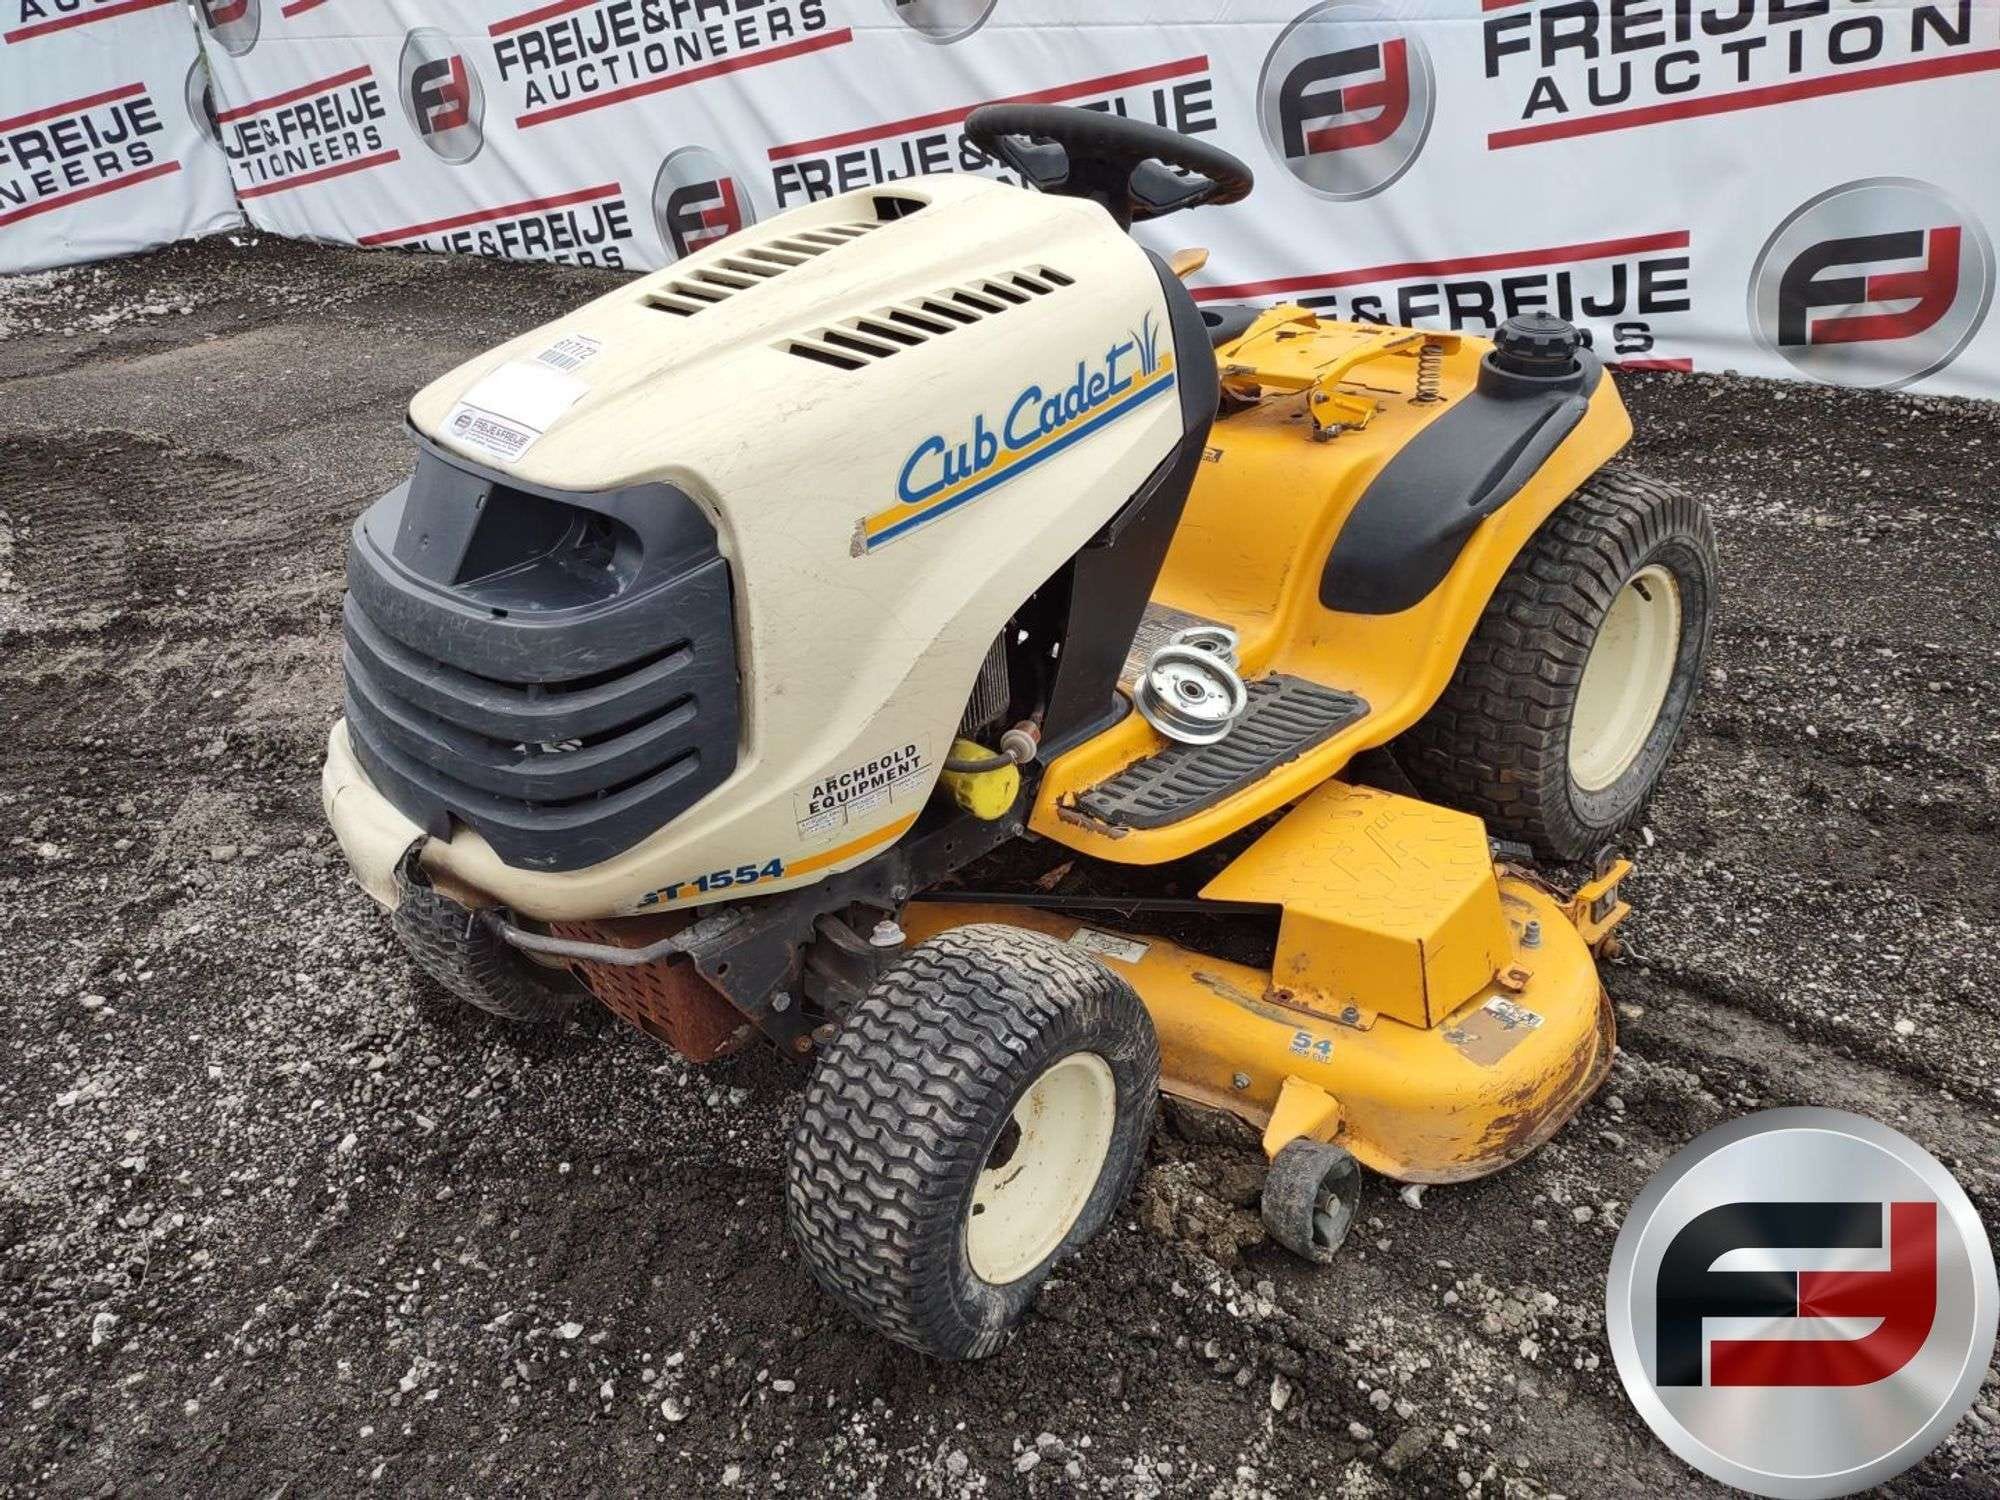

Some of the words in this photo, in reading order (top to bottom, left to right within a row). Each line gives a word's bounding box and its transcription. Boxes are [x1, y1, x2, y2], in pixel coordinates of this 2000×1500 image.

[526, 0, 826, 109] AUCTIONEERS
[897, 415, 998, 504] Cub
[1003, 341, 1134, 450] Cadet
[808, 756, 922, 815] EQUIPMENT
[811, 744, 917, 799] ARCHBOLD
